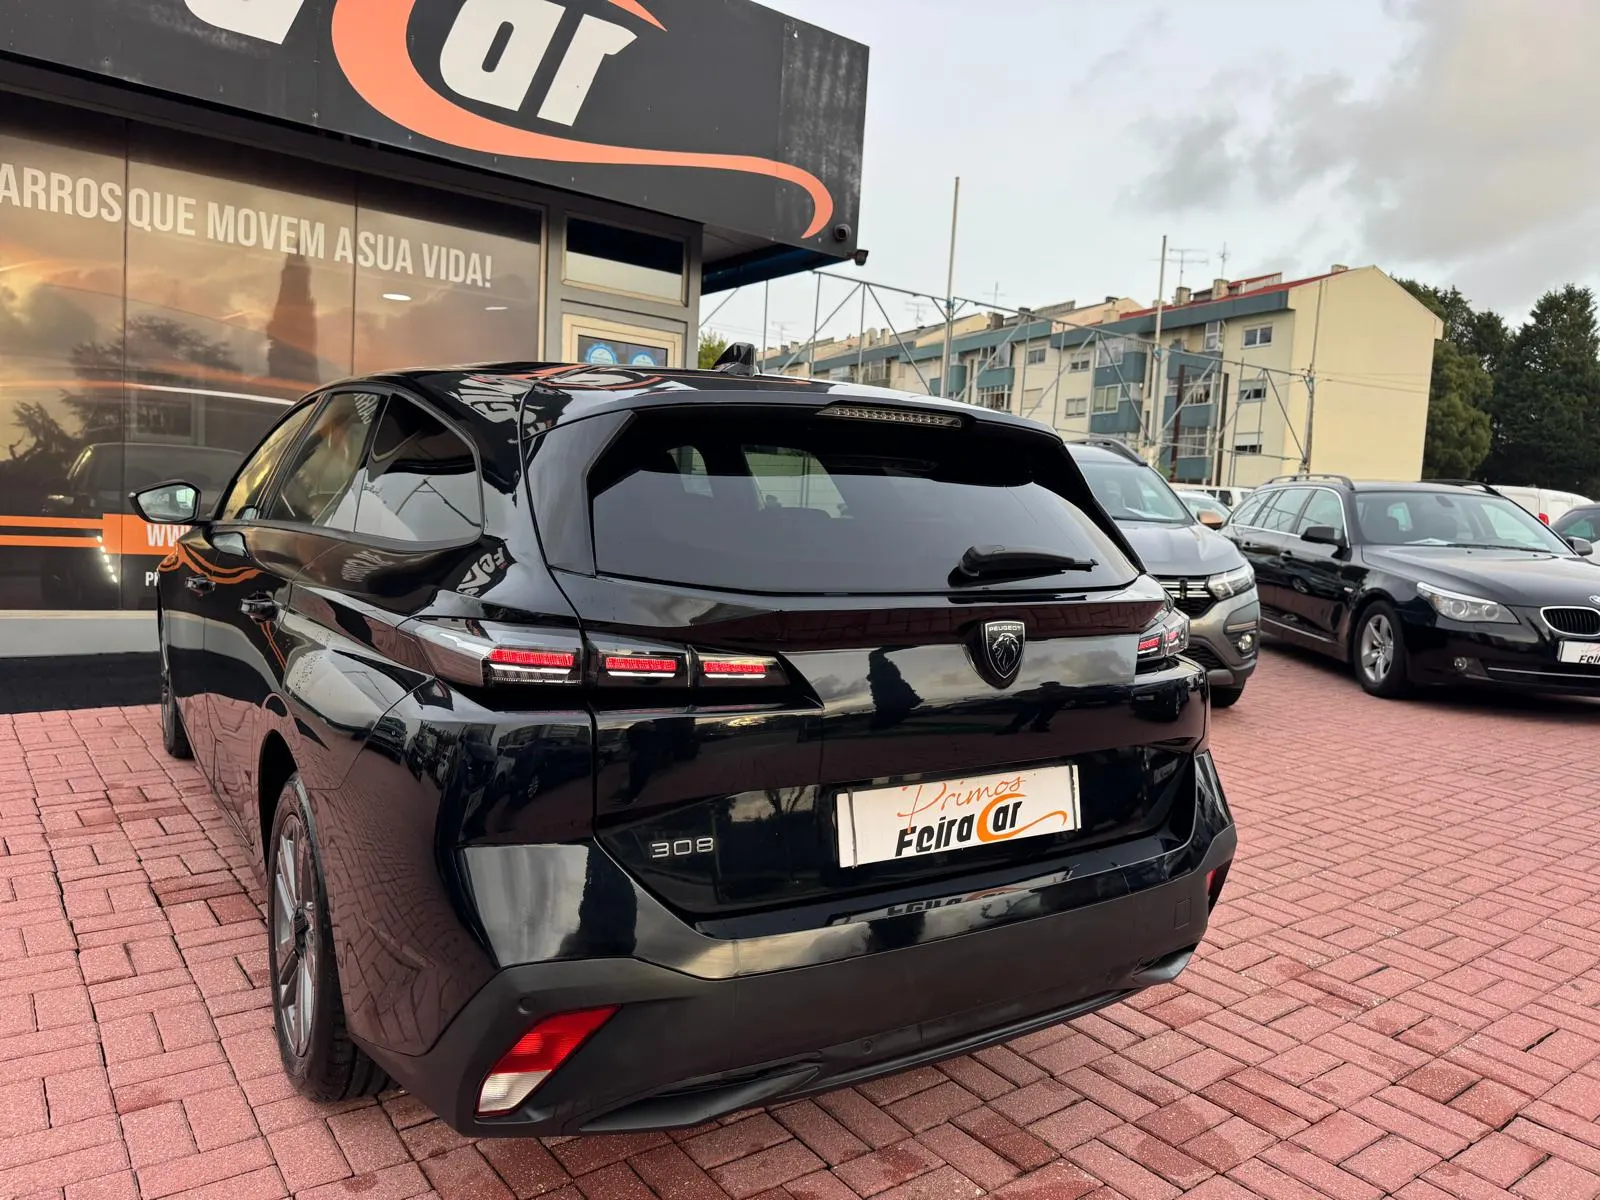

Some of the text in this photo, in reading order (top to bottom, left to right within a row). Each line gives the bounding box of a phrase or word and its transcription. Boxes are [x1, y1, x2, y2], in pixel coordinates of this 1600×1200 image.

[0, 162, 492, 288] ARROS QUE MOVEM A SUA VIDA!
[897, 776, 1027, 833] Primos
[651, 837, 714, 858] 308
